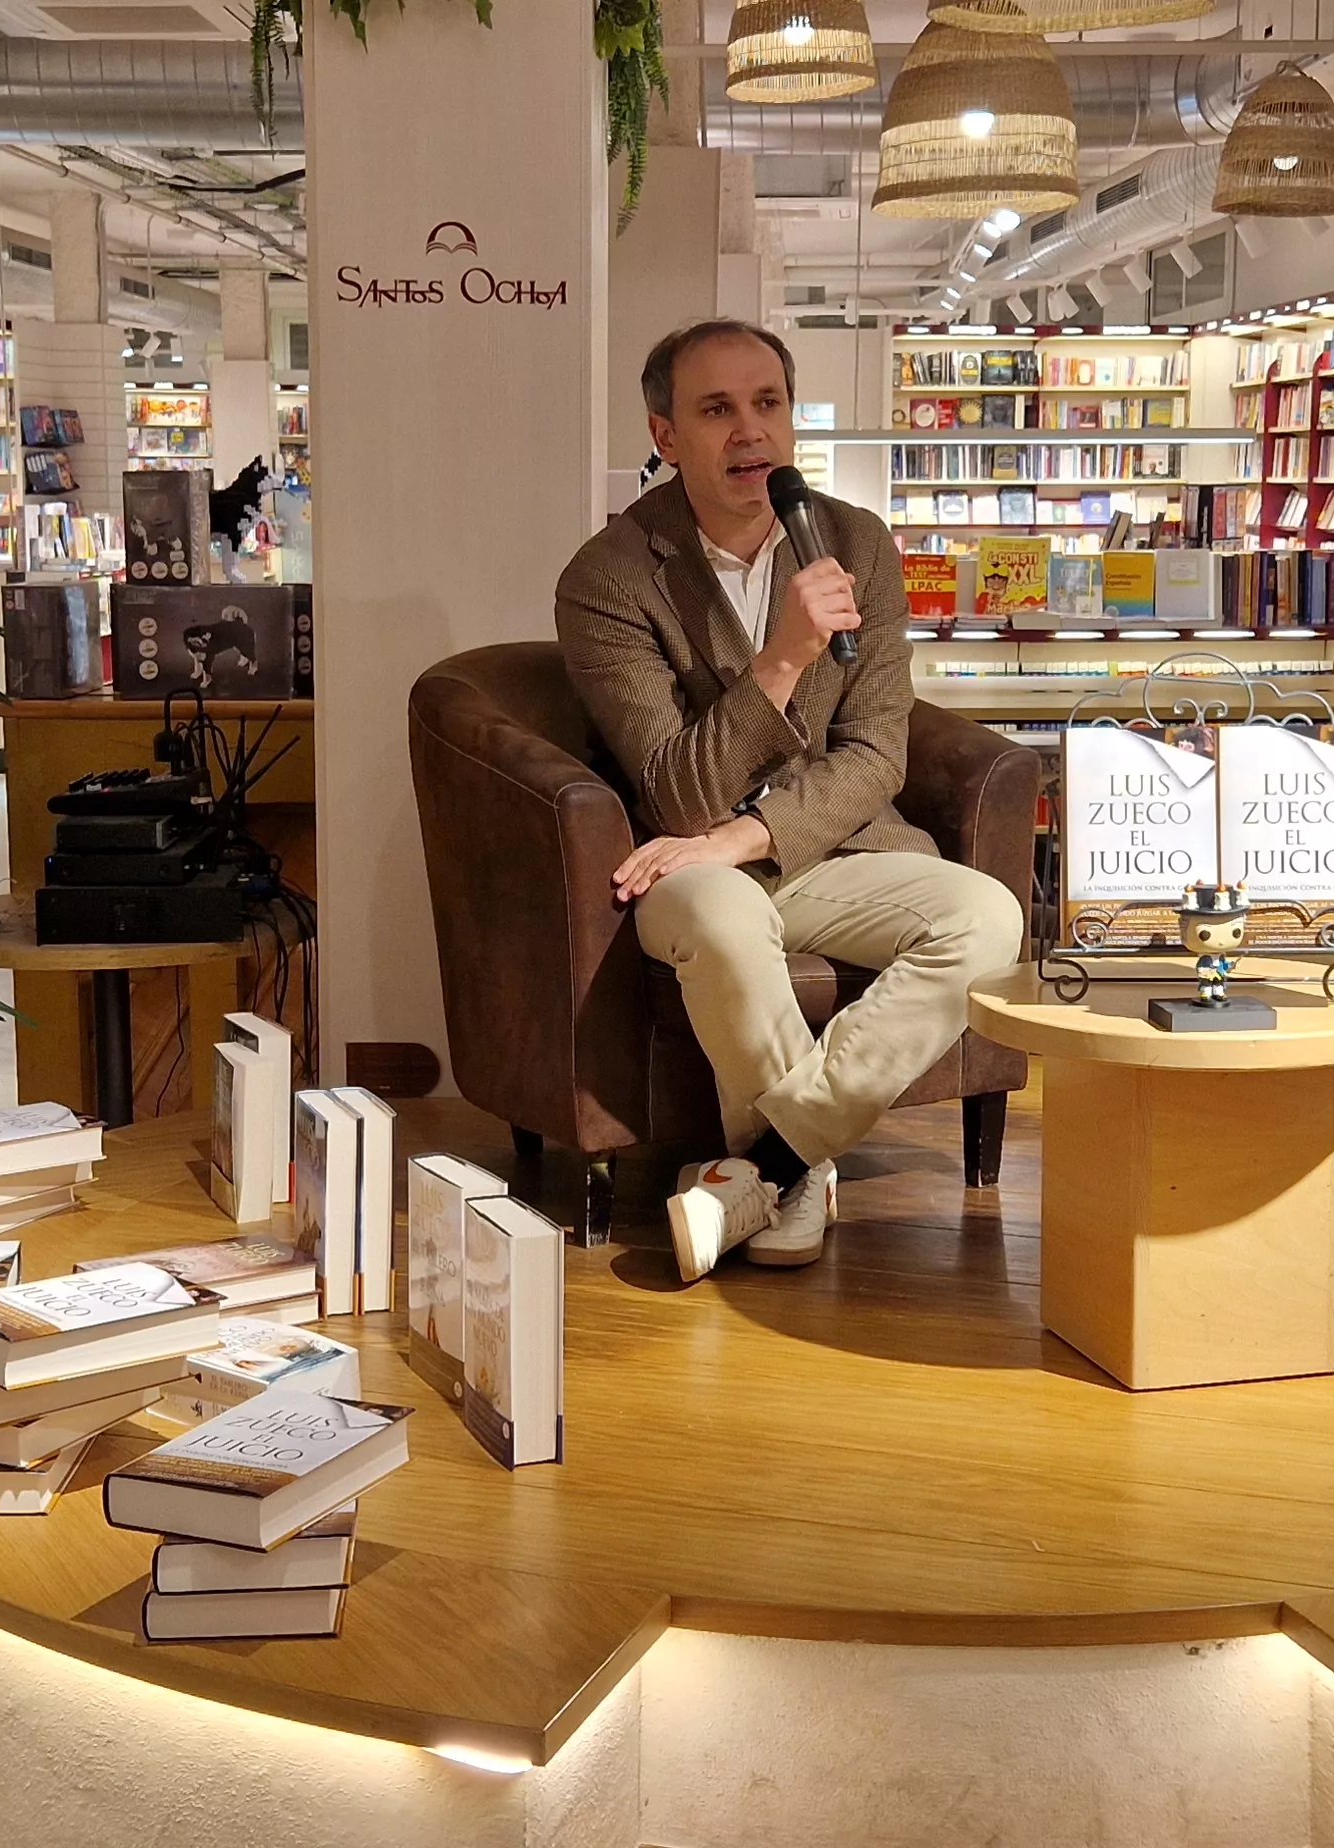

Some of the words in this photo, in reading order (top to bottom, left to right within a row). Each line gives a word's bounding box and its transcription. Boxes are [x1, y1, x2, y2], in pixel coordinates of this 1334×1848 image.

[997, 552, 1039, 565] CONSTI
[910, 581, 943, 592] LPAC
[1007, 564, 1042, 586] XXL
[1109, 773, 1171, 798] LUIS
[1263, 772, 1326, 796] LUIS
[1087, 801, 1192, 826] ZUECO
[1130, 829, 1152, 847] EL
[1285, 829, 1307, 846] EL
[1087, 849, 1193, 882] JUICIO
[14, 1286, 92, 1318] JUICIO
[62, 1277, 139, 1309] ZUECO
[102, 1278, 159, 1302] LUIS
[224, 1415, 337, 1442] ZUECO
[266, 1408, 340, 1430] LUIS
[184, 1434, 305, 1463] JUICIO
[251, 1432, 274, 1444] EL
